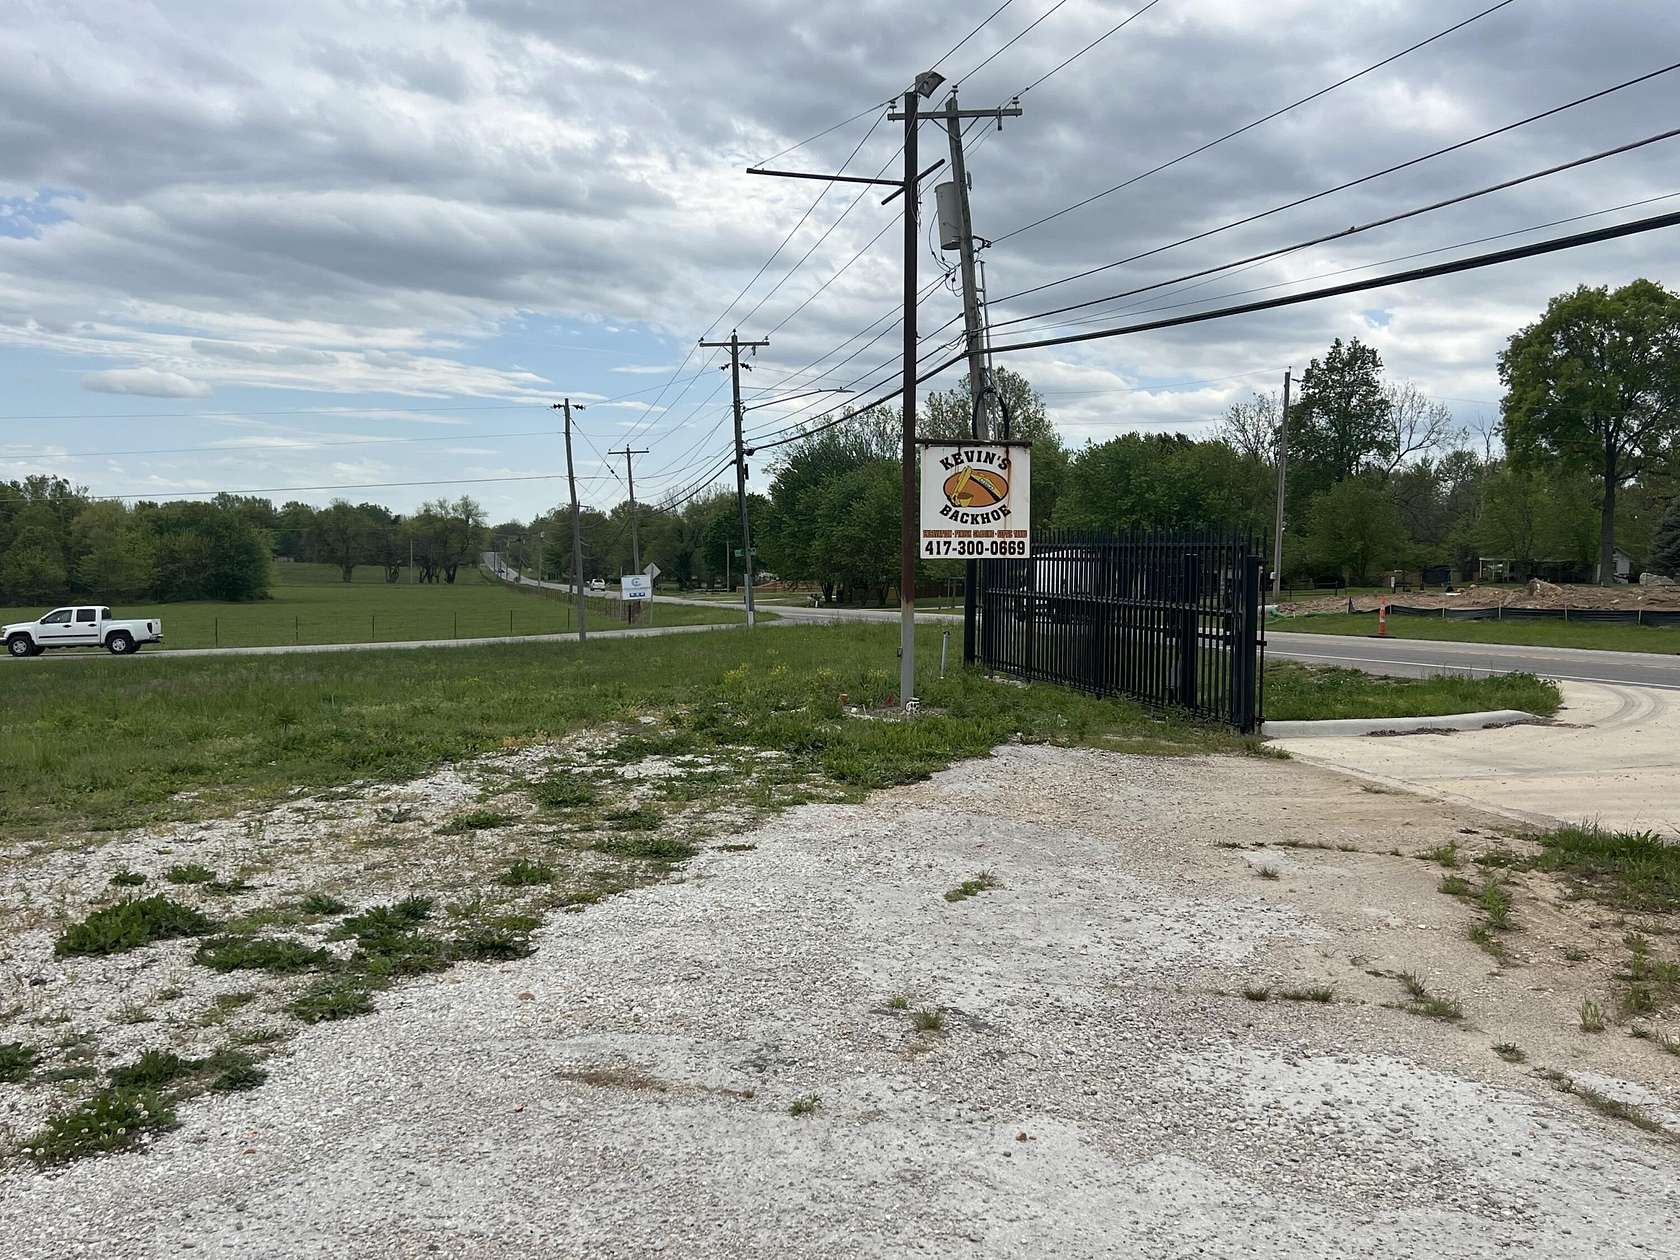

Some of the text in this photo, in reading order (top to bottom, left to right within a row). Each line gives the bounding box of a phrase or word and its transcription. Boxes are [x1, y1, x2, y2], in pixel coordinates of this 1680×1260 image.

[939, 450, 1012, 471] KEVIN'S
[939, 504, 1012, 525] BACKHOE
[925, 540, 1025, 555] 417-300-0669
